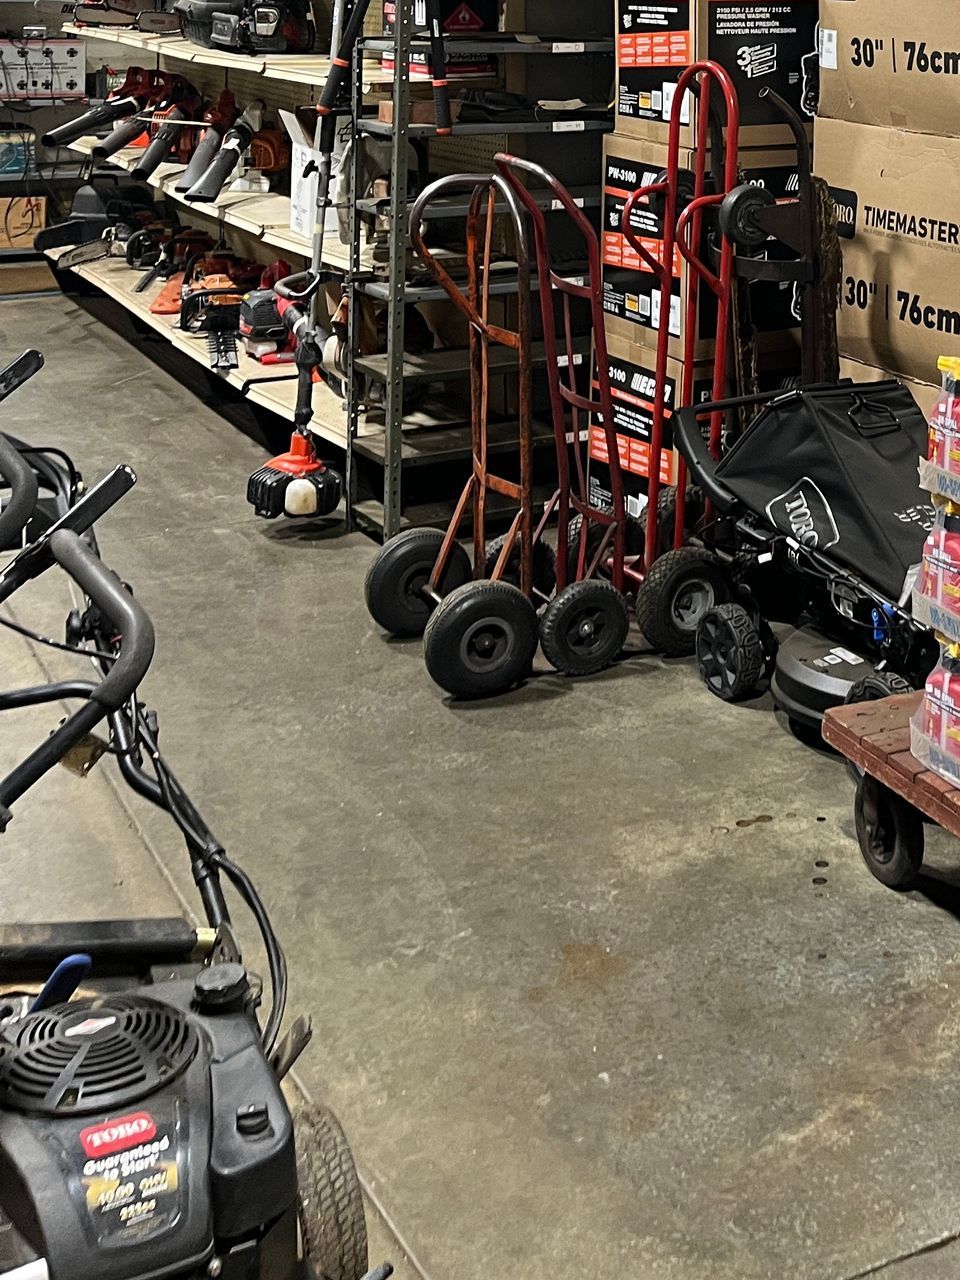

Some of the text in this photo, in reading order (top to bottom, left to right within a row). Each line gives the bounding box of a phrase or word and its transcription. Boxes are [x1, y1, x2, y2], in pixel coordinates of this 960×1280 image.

[608, 167, 637, 184] PW-3100
[834, 203, 853, 224] ORO
[864, 206, 960, 245] TIMEMASTER
[897, 290, 960, 335] 76cm
[786, 491, 819, 548] TORO
[86, 1118, 150, 1147] TORO
[83, 1136, 170, 1176] Guaranteed
